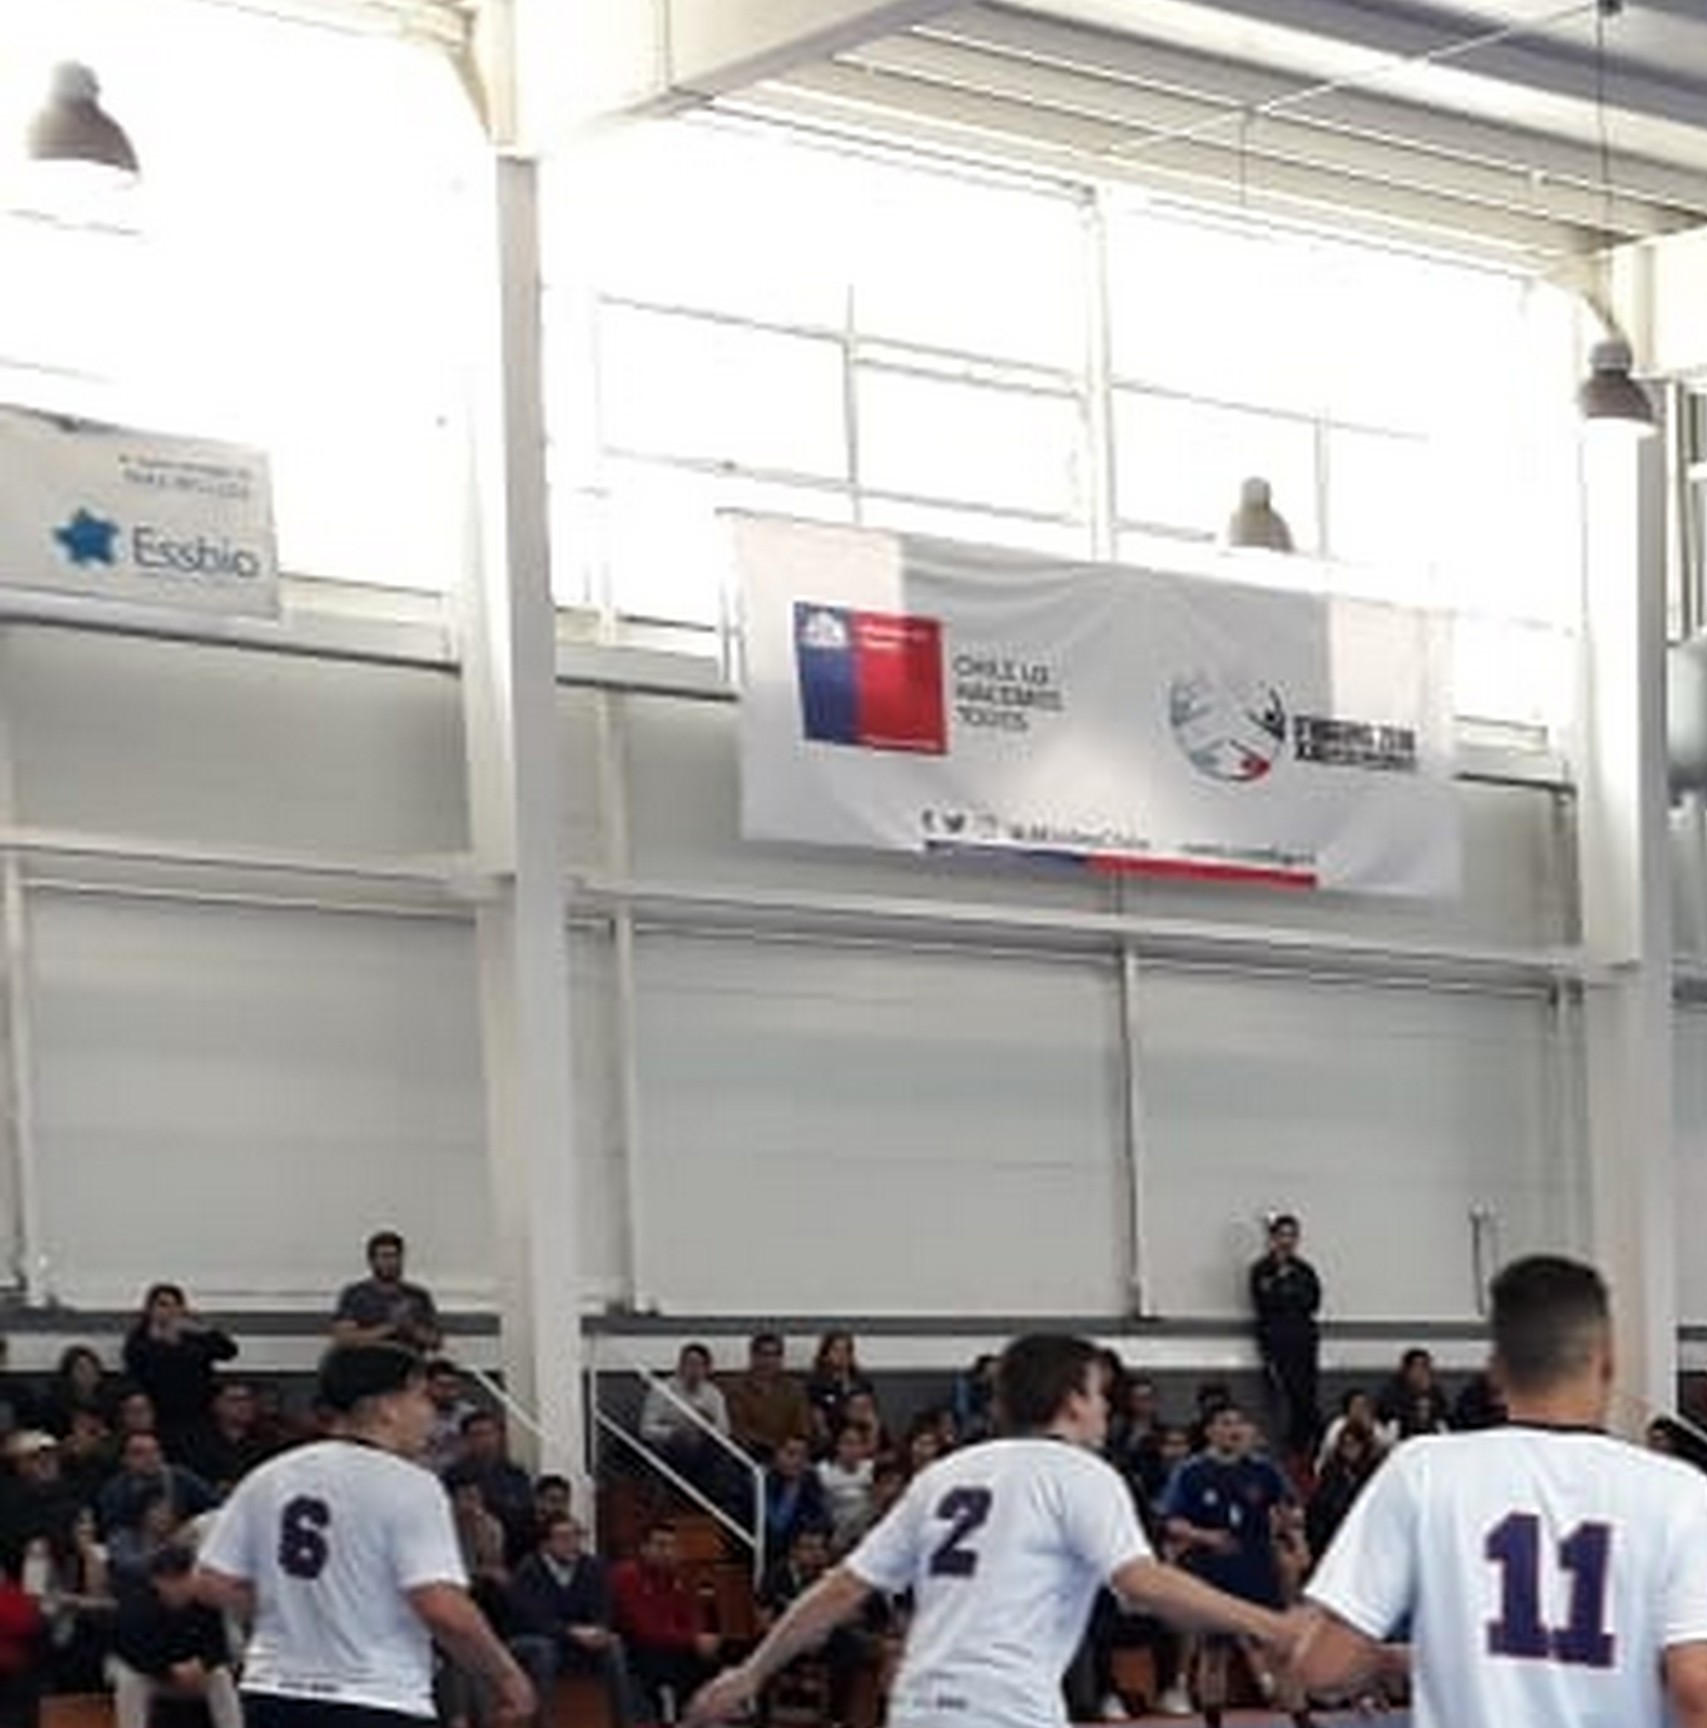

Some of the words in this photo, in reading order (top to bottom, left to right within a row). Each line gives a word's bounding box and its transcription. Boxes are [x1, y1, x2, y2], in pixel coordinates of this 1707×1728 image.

[133, 526, 260, 578] Essbio
[279, 1494, 330, 1580] 6
[930, 1487, 992, 1577] 2
[1484, 1511, 1615, 1669] 11
